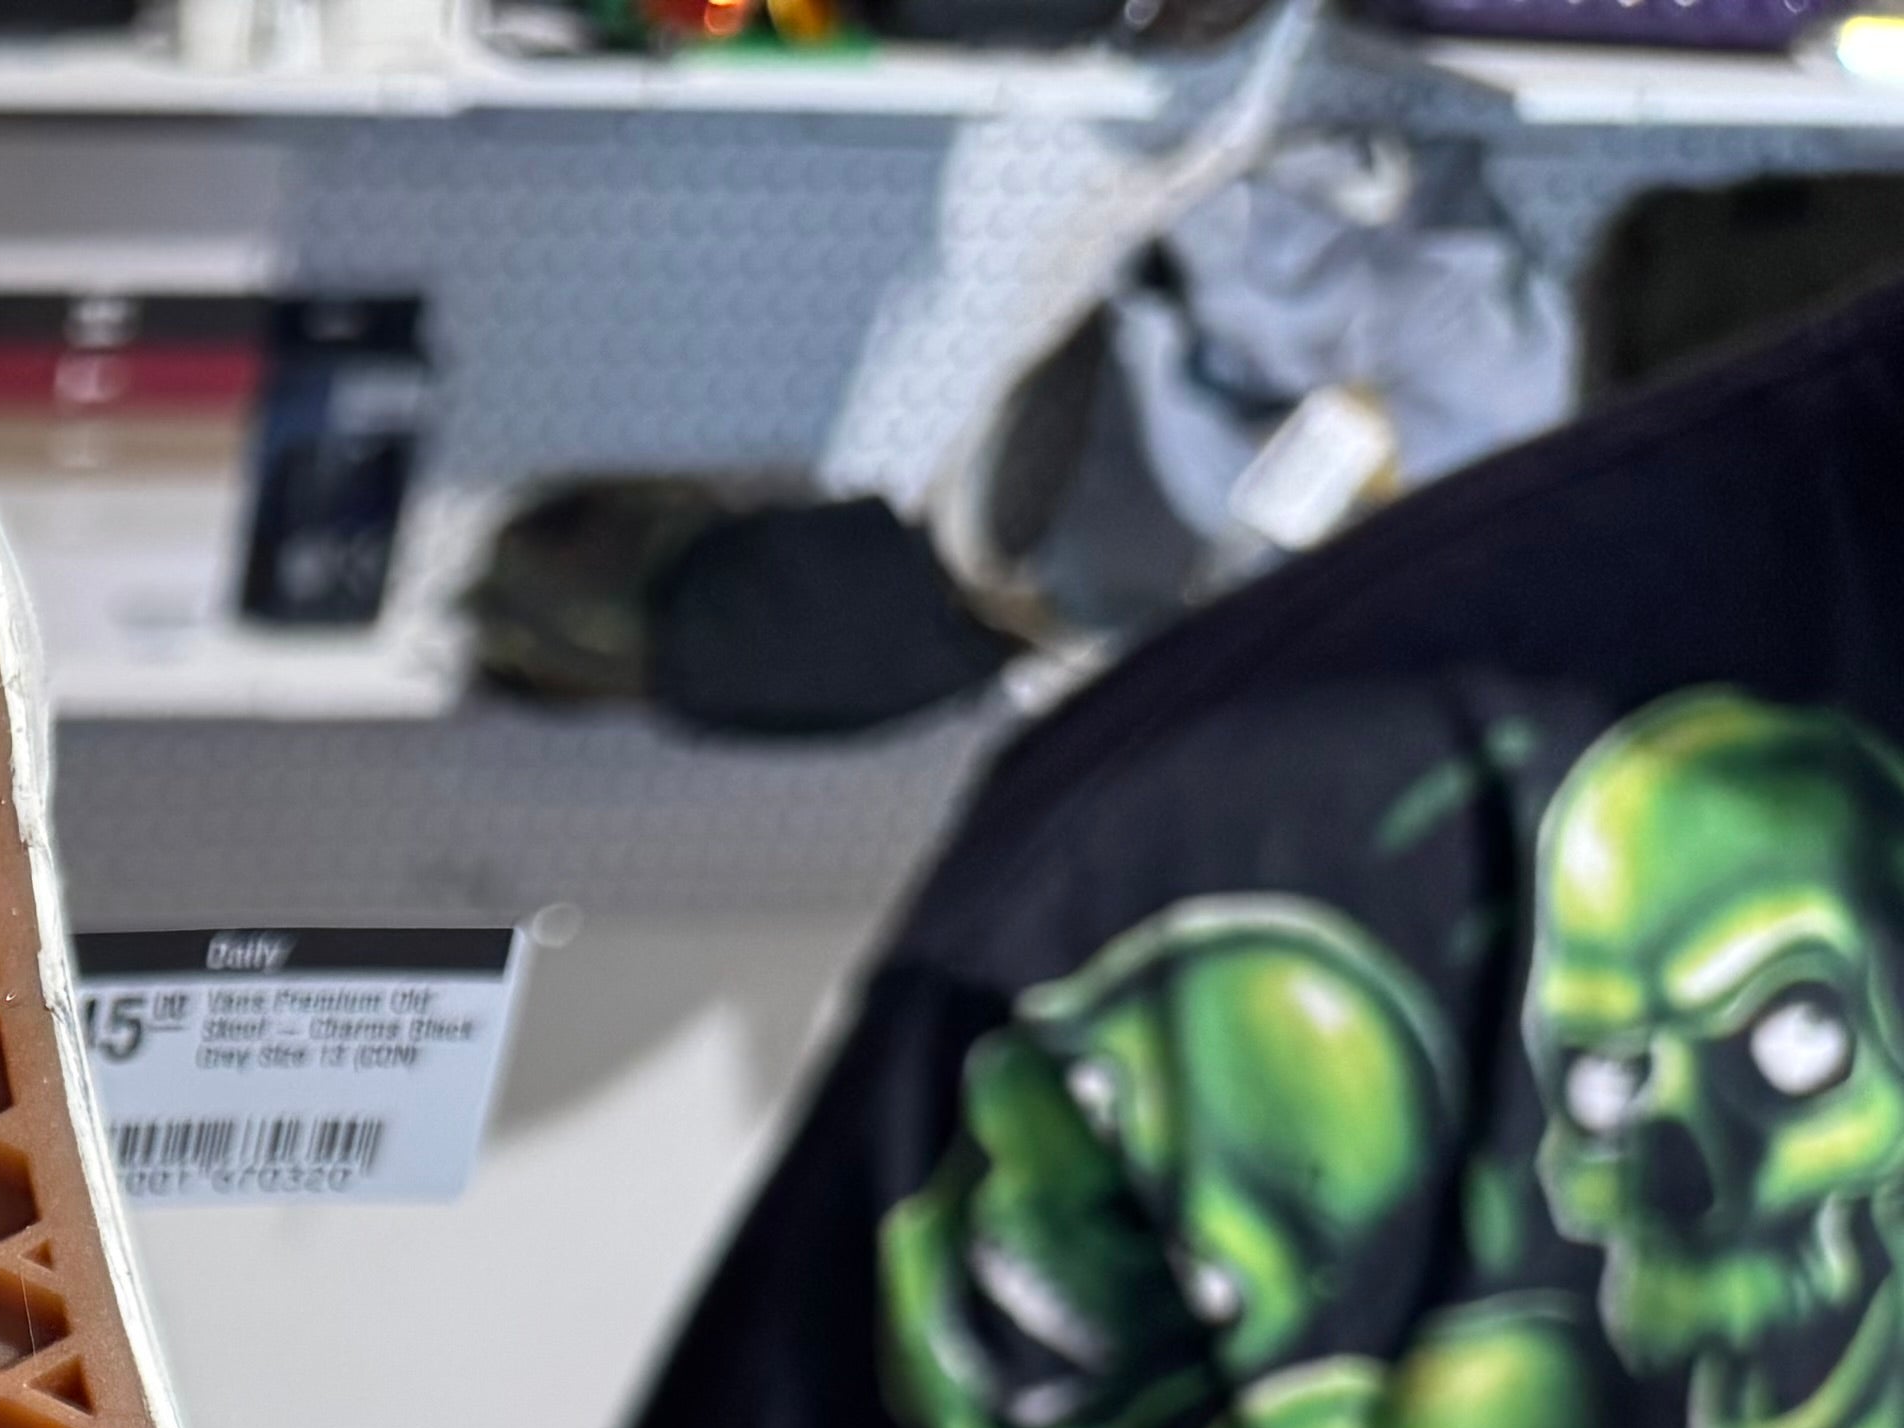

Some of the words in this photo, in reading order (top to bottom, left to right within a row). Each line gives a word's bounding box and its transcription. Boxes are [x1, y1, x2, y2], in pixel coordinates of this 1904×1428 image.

[205, 932, 290, 971] Daily
[208, 990, 266, 1014] Vans
[272, 989, 382, 1014] Premium
[388, 988, 433, 1014] Old
[201, 1016, 266, 1042] Skool
